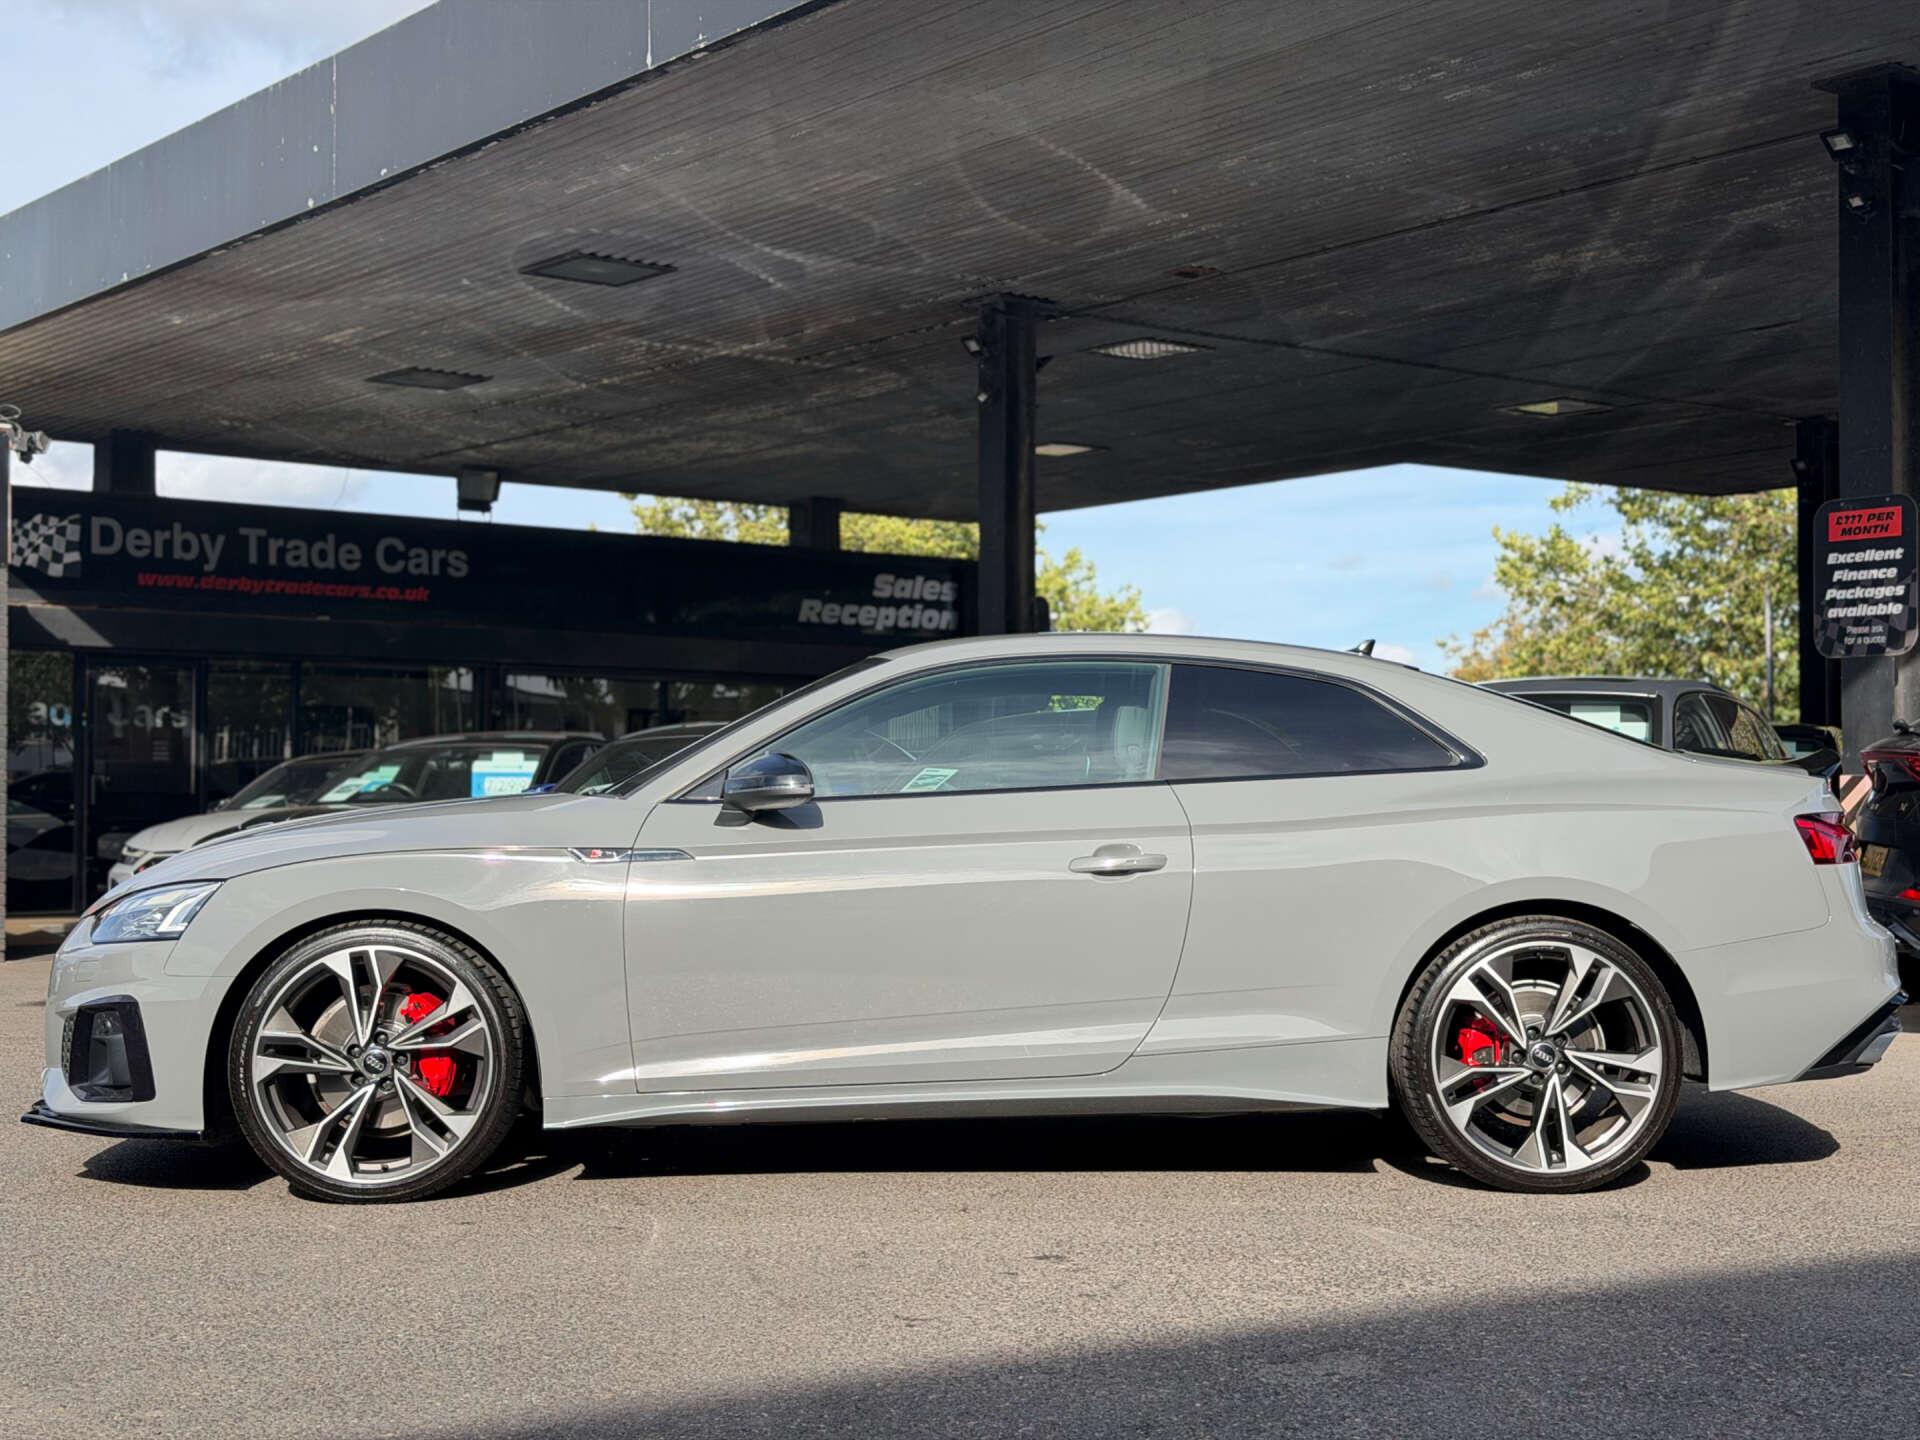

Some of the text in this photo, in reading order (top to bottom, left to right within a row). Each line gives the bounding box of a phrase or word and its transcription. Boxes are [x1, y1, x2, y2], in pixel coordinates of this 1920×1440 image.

[1867, 511, 1896, 523] PER
[1840, 523, 1890, 537] MONTH
[90, 516, 470, 578] Derby Trade Cars
[1826, 547, 1905, 566] Excellent
[1832, 566, 1898, 583] Finance
[136, 571, 430, 603] www.derbytradecars.co.uk
[872, 573, 959, 602] Sales
[1825, 584, 1906, 601] Packages
[798, 598, 959, 632] Reception
[1827, 602, 1904, 619] available
